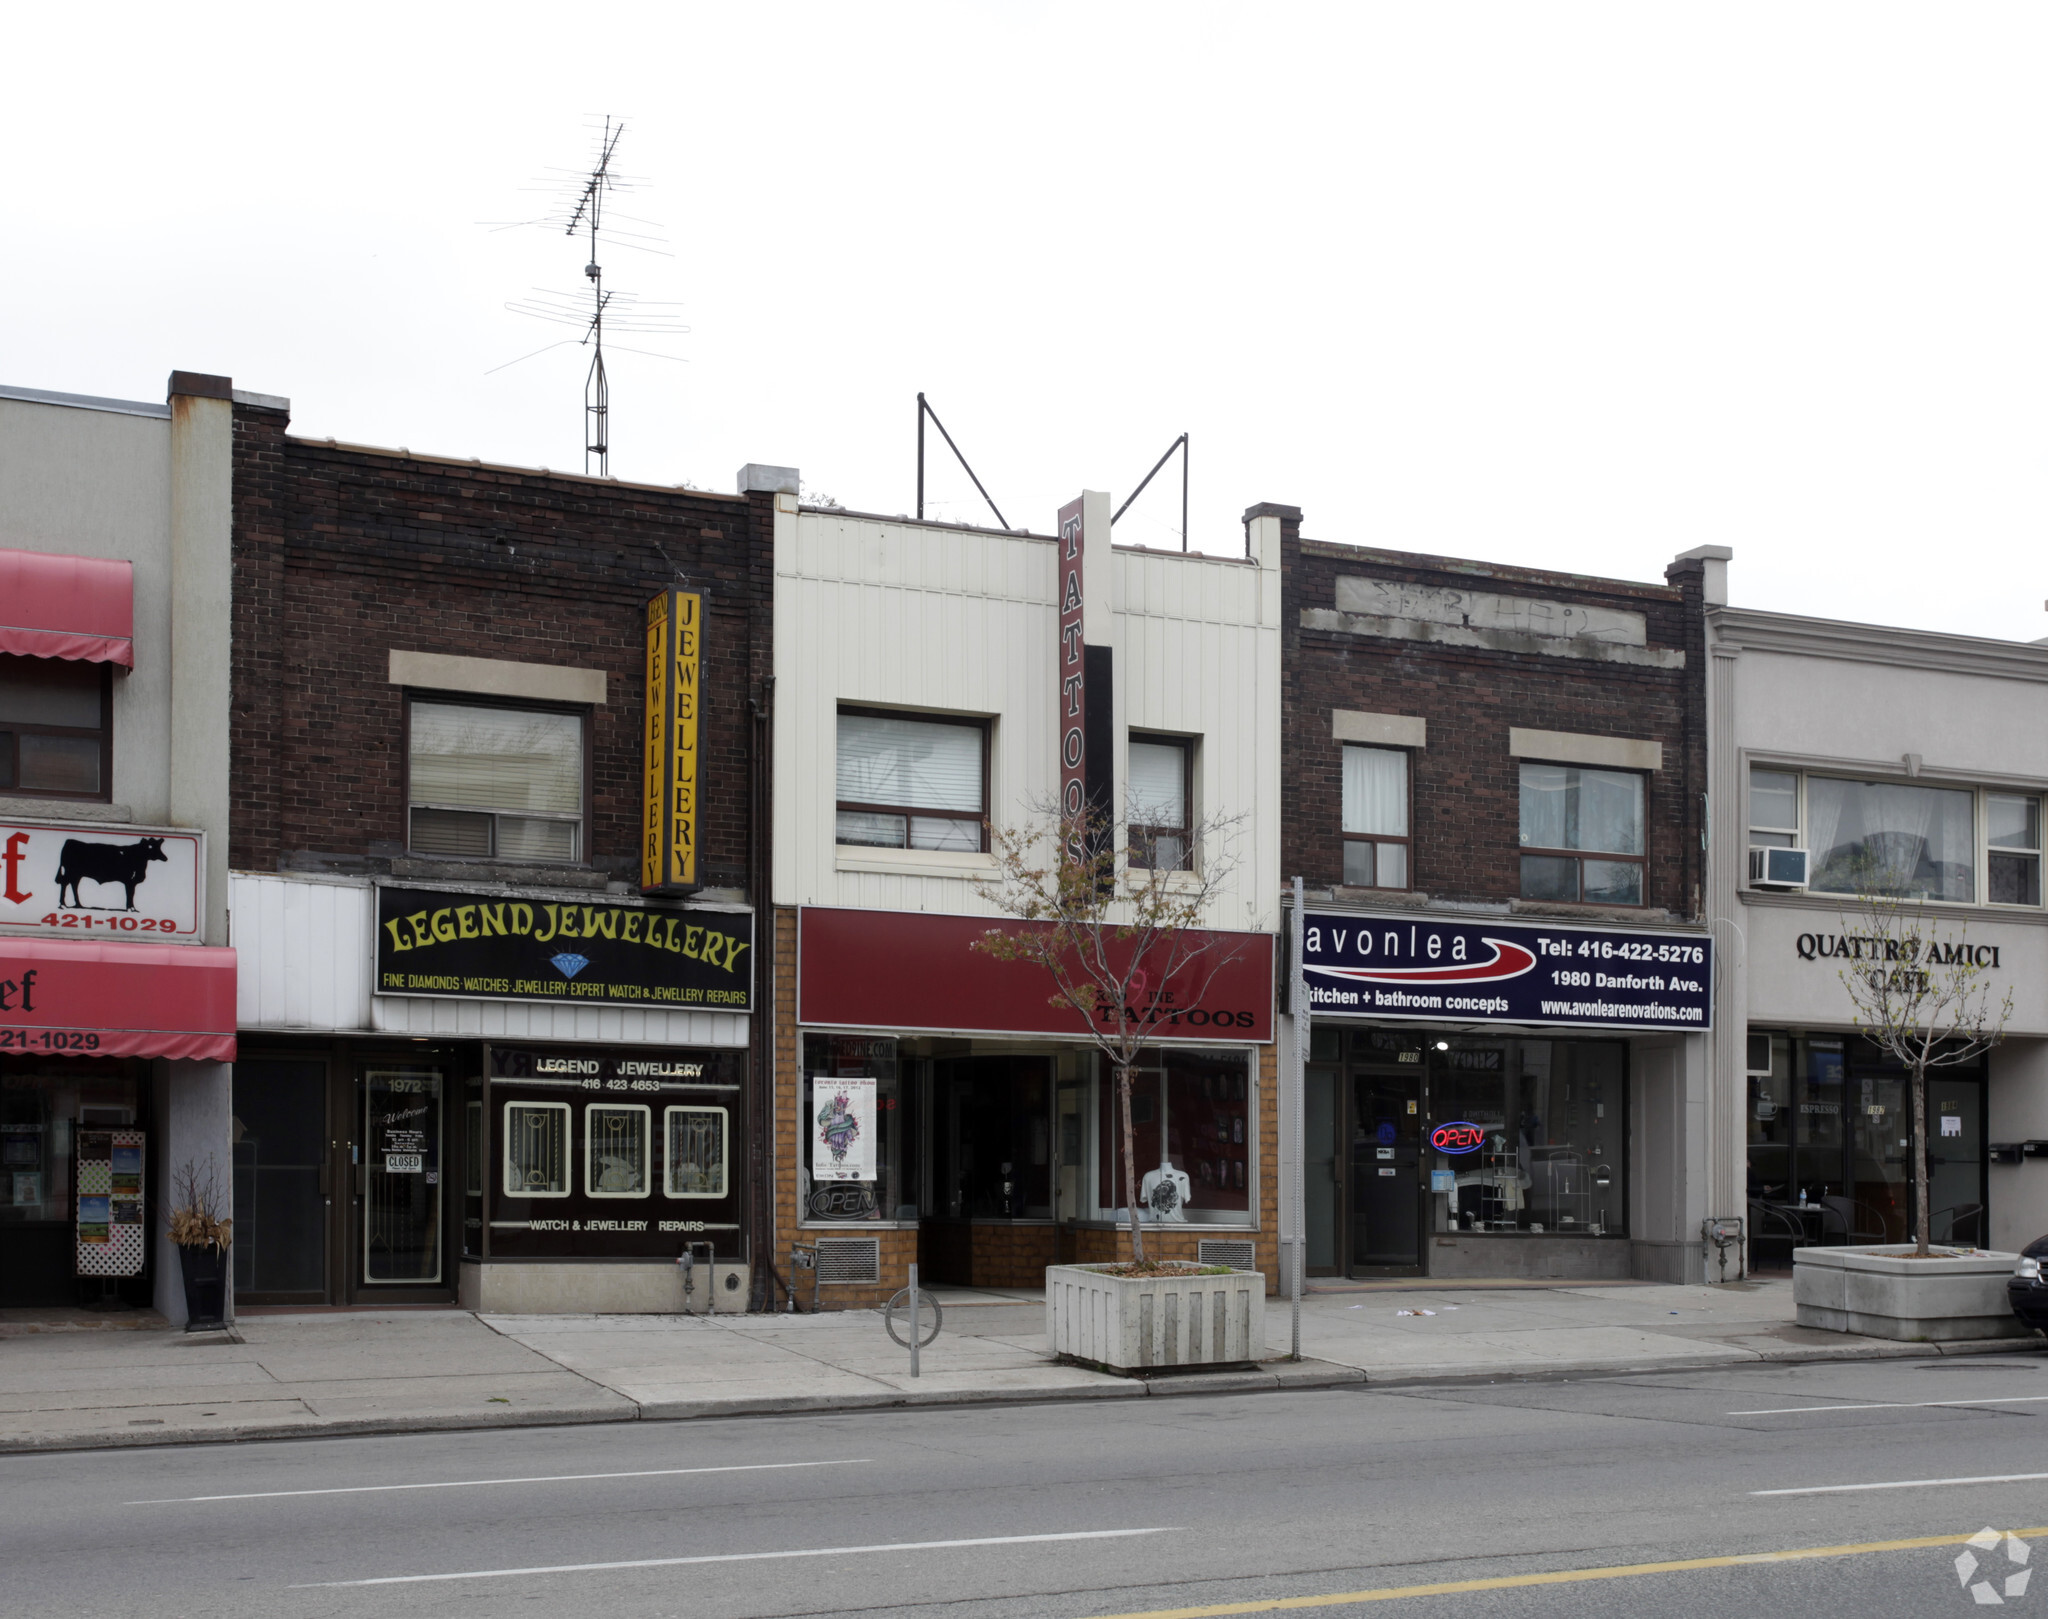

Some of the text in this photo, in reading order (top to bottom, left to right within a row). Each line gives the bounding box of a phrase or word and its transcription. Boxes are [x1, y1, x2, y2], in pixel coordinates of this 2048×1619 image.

[1062, 513, 1085, 868] TATTOOS
[674, 599, 696, 877] JEWELLERY
[647, 626, 662, 887] JEWELLERY
[41, 912, 177, 934] 421-1029
[384, 903, 751, 973] LEGEND JEWELLERY
[1306, 925, 1467, 961] avonlea
[1537, 938, 1703, 964] Tel: 416-422-5276
[1796, 933, 2000, 968] QUATTRO AMICI
[383, 973, 747, 1004] FINE DIAMONDS WATCHES JEWELLERY EXPERT WATCH & JEWELLERY REPAIRS
[1551, 970, 1703, 992] 1980 Danforth Ave.
[1362, 990, 1371, 1003] +
[1375, 989, 1442, 1009] bathroom
[1445, 995, 1509, 1014] concepts
[1540, 999, 1703, 1021] www.avonlearenovations.com
[1096, 1004, 1255, 1028] TATTOOS
[0, 1030, 100, 1050] 21-1029
[536, 1058, 599, 1074] LEGEND
[617, 1060, 703, 1077] JEWELLERY
[1399, 1052, 1419, 1063] 1980
[388, 1079, 422, 1093] 1972
[581, 1078, 660, 1091] 416 423 4653
[383, 1106, 429, 1124] Welcome
[1800, 1104, 1839, 1114] ESPRESSO
[1433, 1128, 1485, 1147] OPEN
[389, 1156, 419, 1167] CLOSED
[813, 1191, 876, 1211] OPEN
[529, 1219, 705, 1232] WATCH & JEWELLERY REPAIRS
